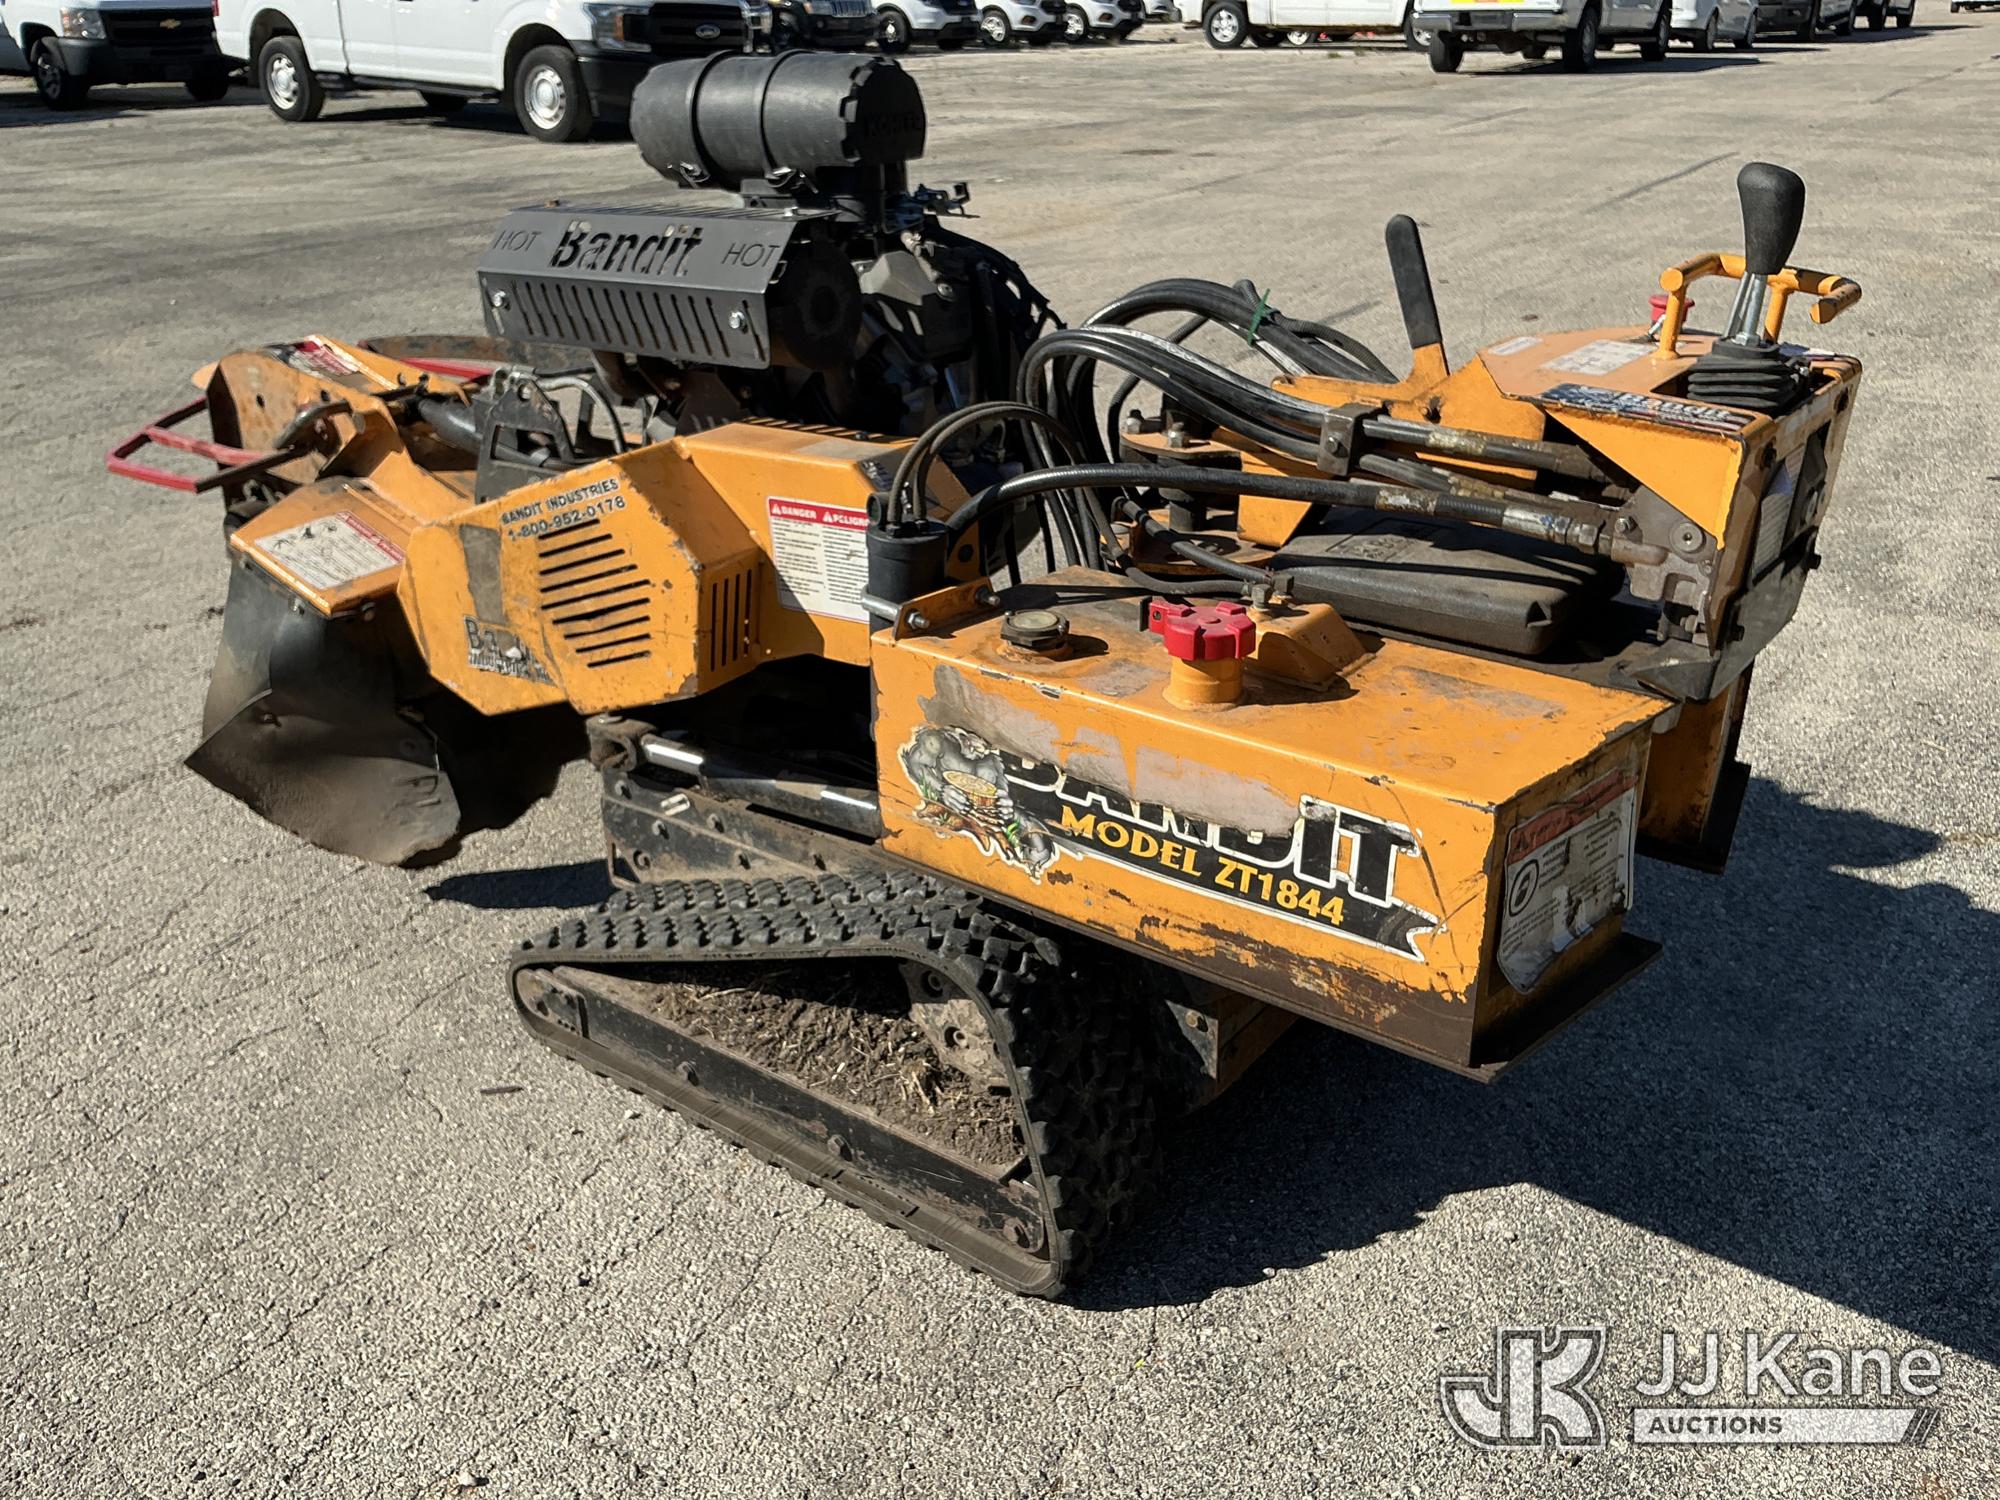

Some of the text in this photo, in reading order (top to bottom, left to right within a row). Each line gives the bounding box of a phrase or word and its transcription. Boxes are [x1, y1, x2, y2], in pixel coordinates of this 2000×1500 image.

[492, 230, 542, 251] HOT
[549, 220, 704, 277] Bandit
[720, 242, 781, 268] HOT
[501, 478, 619, 525] BANDIT INDUSTRIES
[508, 496, 626, 541] 1-800-952-0178
[780, 506, 817, 519] DANGER
[1060, 805, 1202, 877] MODEL
[1214, 857, 1344, 926] ZT1844
